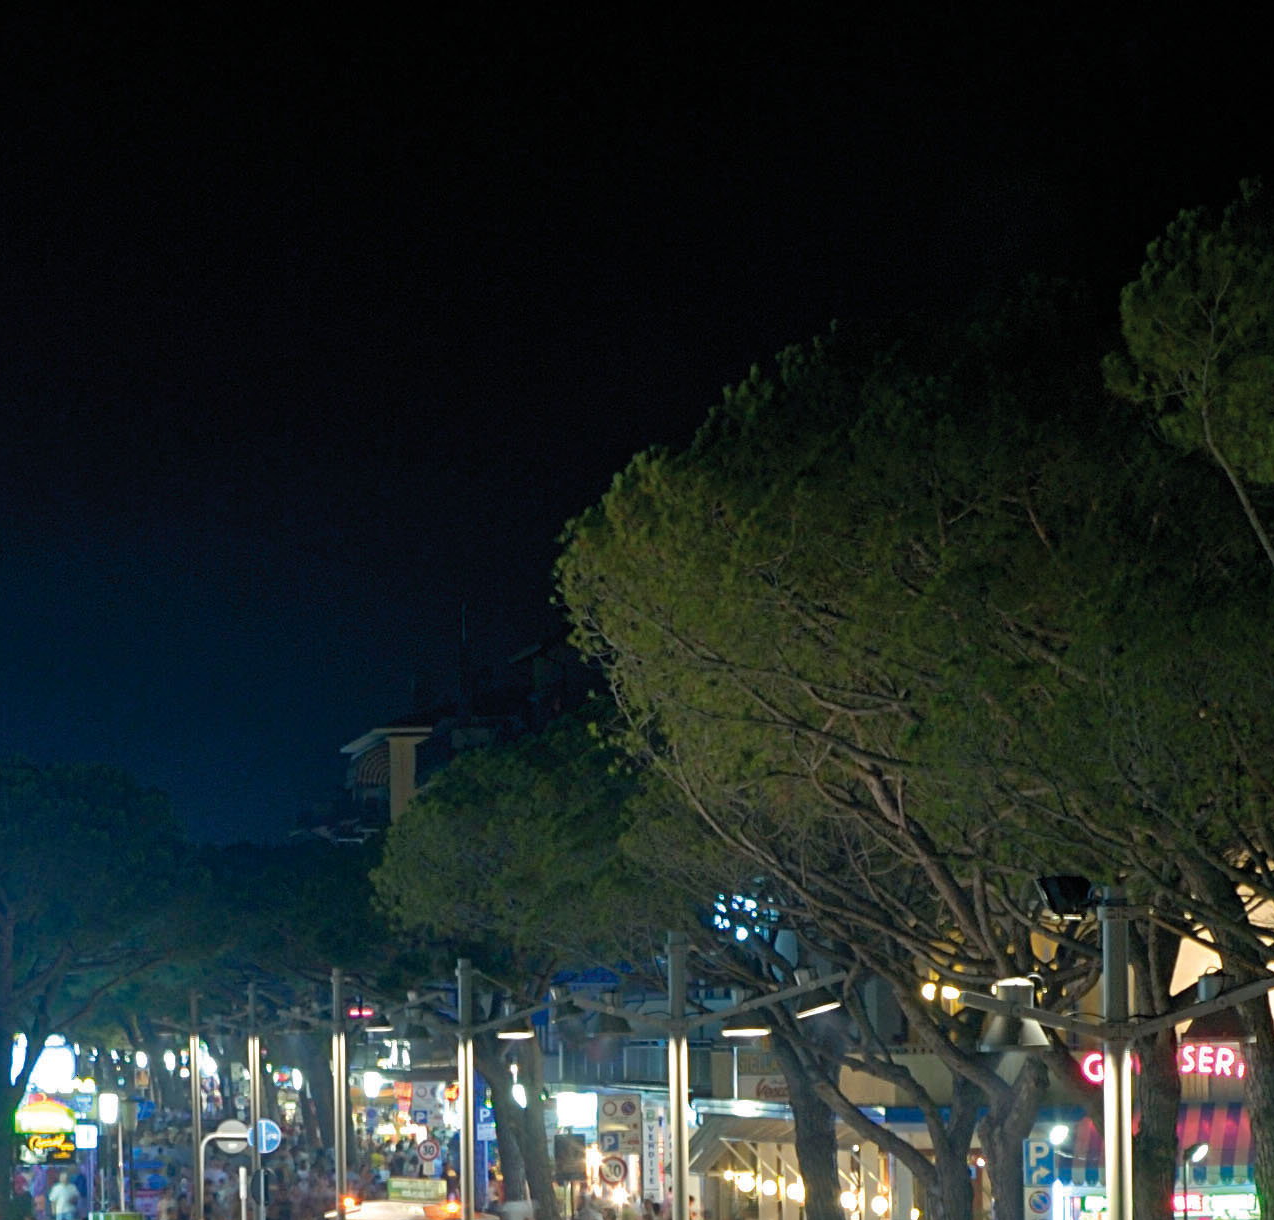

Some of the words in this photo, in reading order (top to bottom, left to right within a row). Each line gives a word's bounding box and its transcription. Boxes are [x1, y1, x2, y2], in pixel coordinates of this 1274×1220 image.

[603, 1135, 615, 1149] P
[422, 1144, 435, 1157] 30
[1029, 1141, 1050, 1167] P
